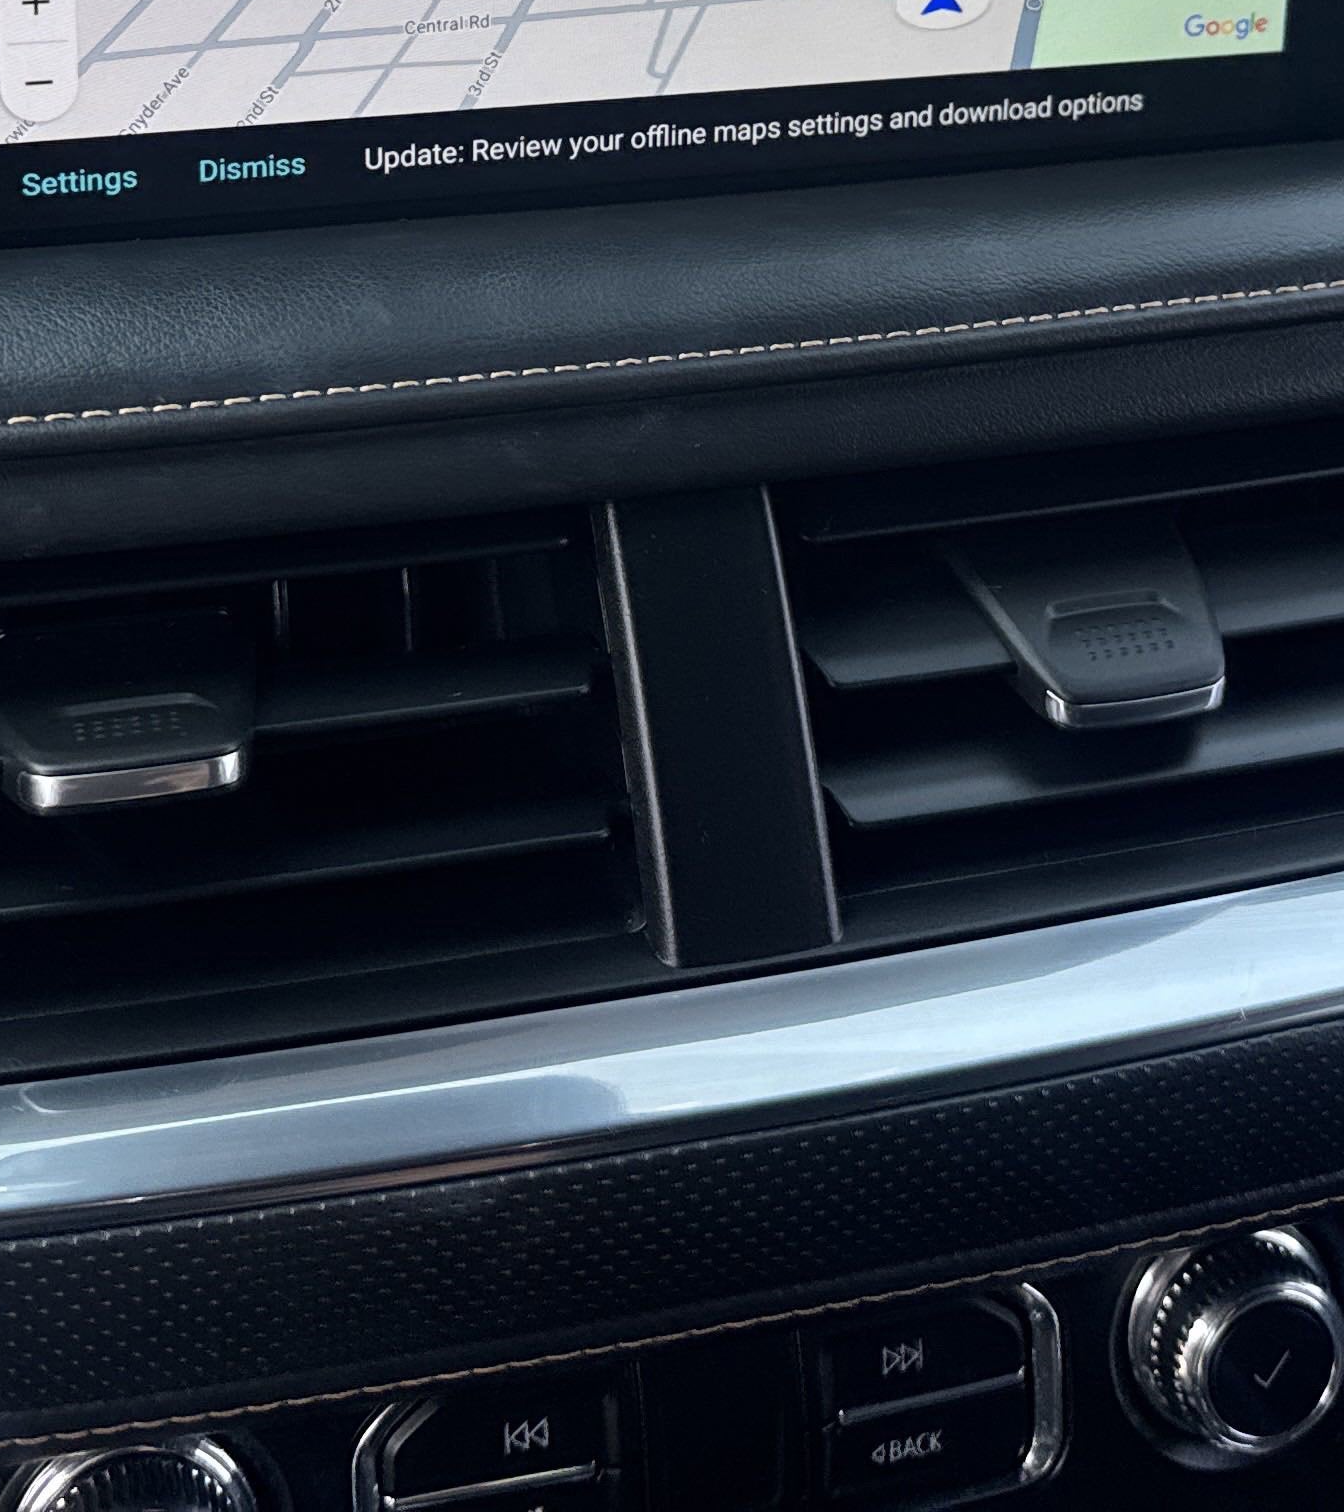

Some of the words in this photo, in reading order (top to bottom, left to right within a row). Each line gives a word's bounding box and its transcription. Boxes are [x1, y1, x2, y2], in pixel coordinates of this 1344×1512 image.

[405, 17, 463, 34] Central
[469, 15, 490, 29] Rd
[1184, 13, 1268, 39] Google
[163, 66, 190, 95] Ave
[468, 69, 492, 97] 3rd
[484, 51, 502, 70] St
[260, 86, 279, 104] St
[364, 142, 464, 171] Update:
[472, 134, 562, 162] Review
[568, 131, 623, 159] your
[630, 124, 706, 150] offline
[713, 120, 781, 146] maps
[787, 112, 883, 139] settings
[889, 105, 932, 129] and
[939, 95, 1052, 125] download
[1057, 92, 1144, 120] options
[21, 168, 138, 197] Settings
[198, 154, 306, 183] Dismiss
[889, 1430, 944, 1462] BACK
